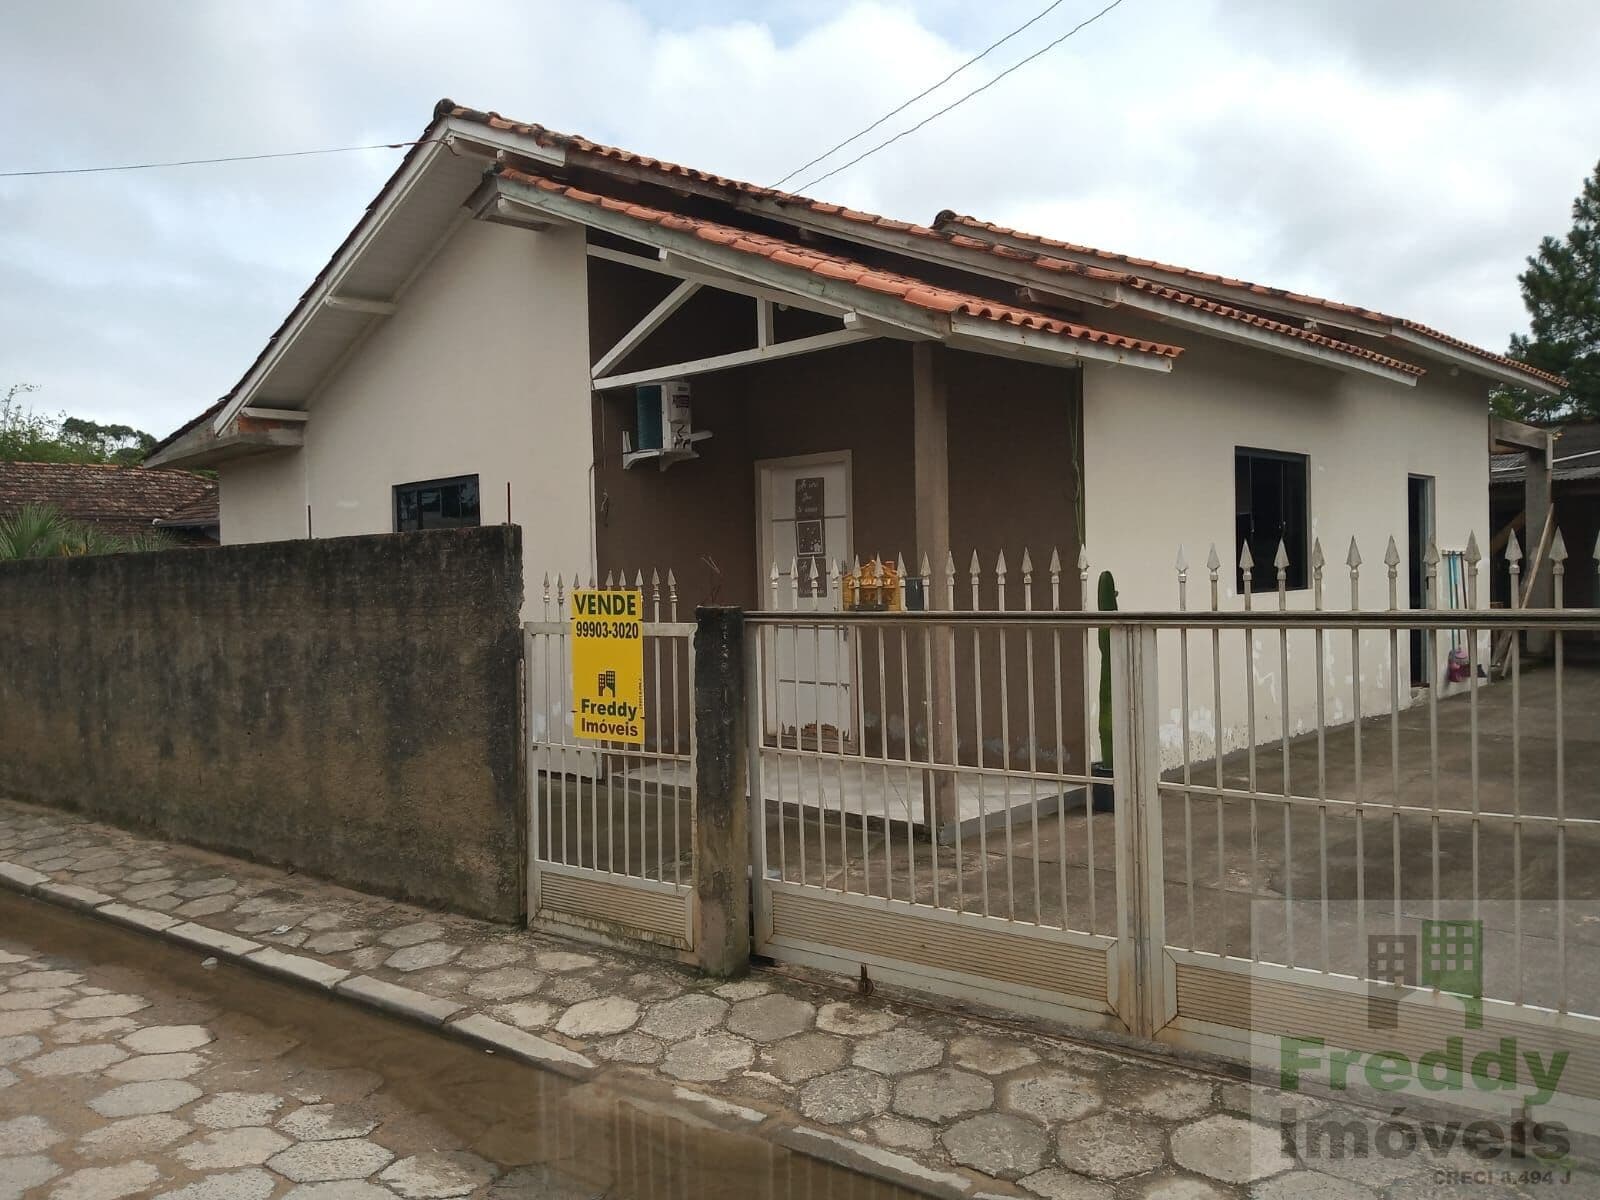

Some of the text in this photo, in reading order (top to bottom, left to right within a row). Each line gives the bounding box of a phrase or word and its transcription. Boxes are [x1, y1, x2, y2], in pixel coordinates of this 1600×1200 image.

[574, 595, 636, 615] VENDE
[576, 622, 639, 639] 99903-3020
[581, 699, 637, 721] Freddy
[581, 718, 638, 736] Imóveis
